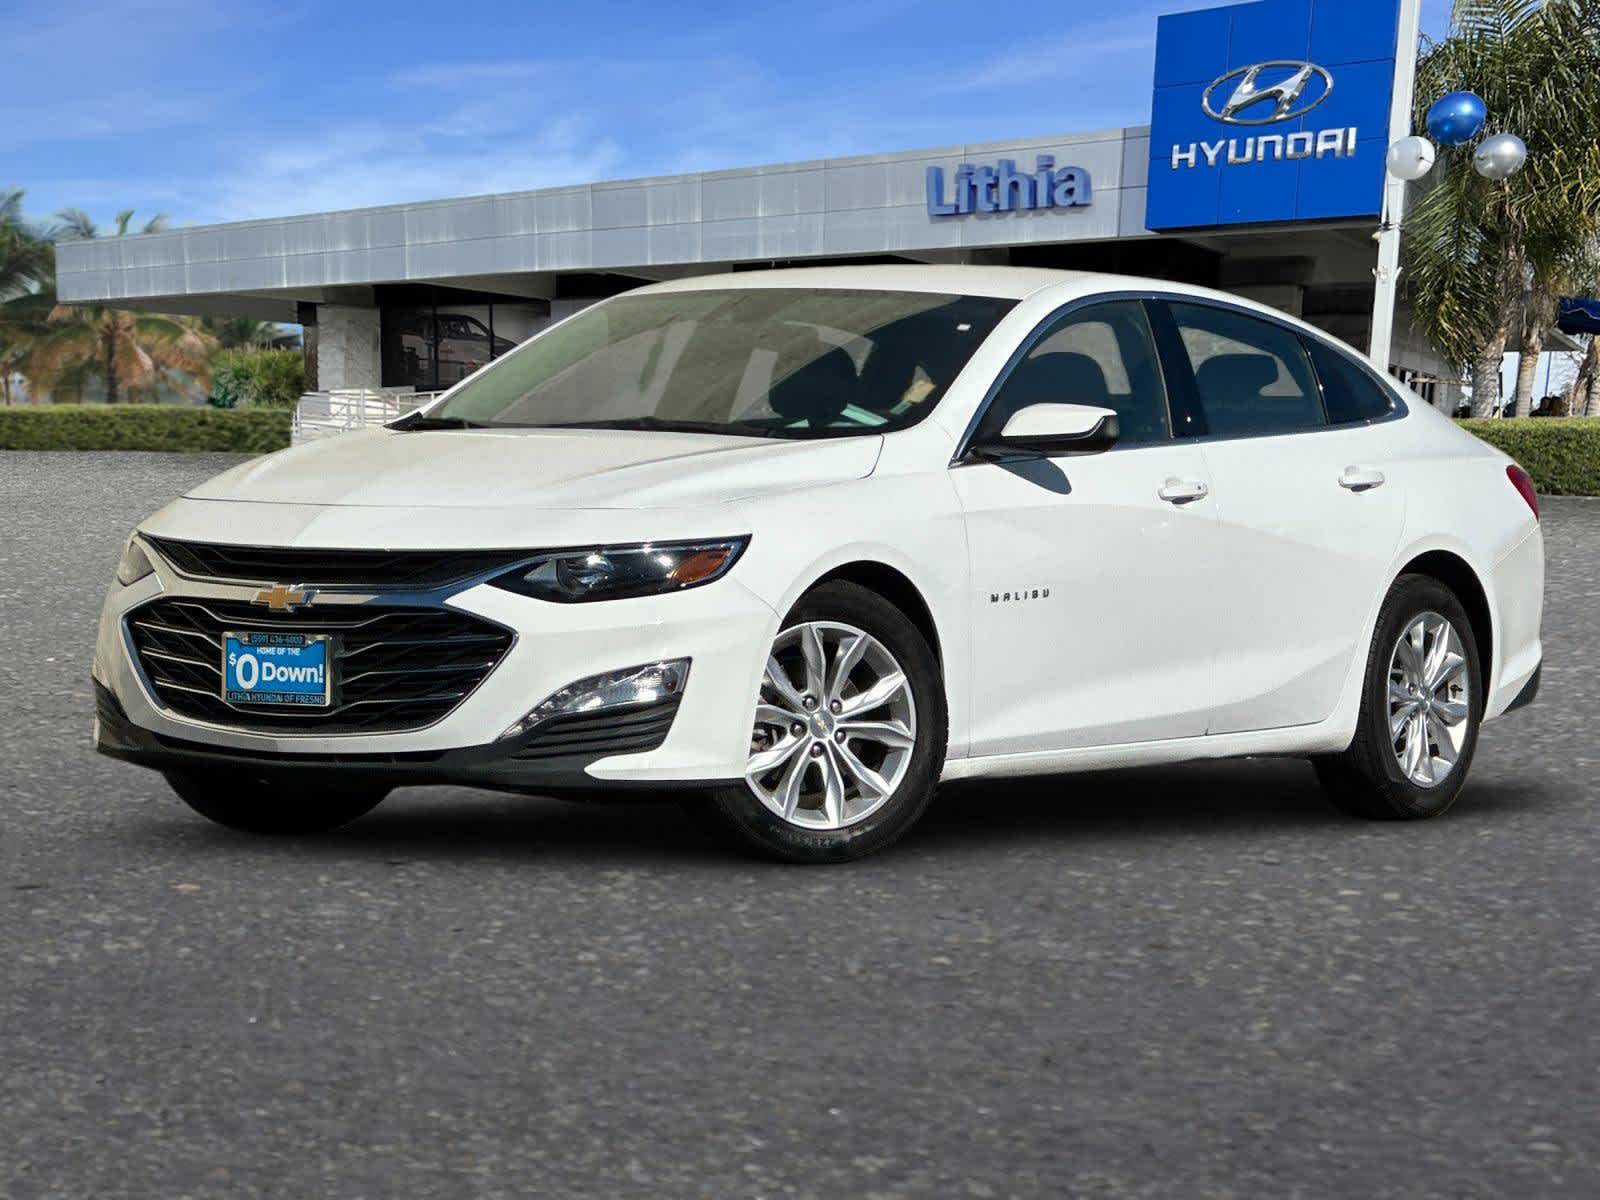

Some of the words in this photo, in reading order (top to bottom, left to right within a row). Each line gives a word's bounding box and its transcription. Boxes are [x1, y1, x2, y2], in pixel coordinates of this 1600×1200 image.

[1170, 126, 1358, 170] HYUNDAI
[926, 154, 1092, 218] Lithia
[990, 588, 1050, 603] MALIBU
[256, 646, 275, 656] HOME
[277, 647, 286, 656] OF
[288, 647, 301, 656] THE
[261, 662, 324, 683] Down!
[284, 693, 295, 703] OF
[295, 693, 325, 704] FRESNO
